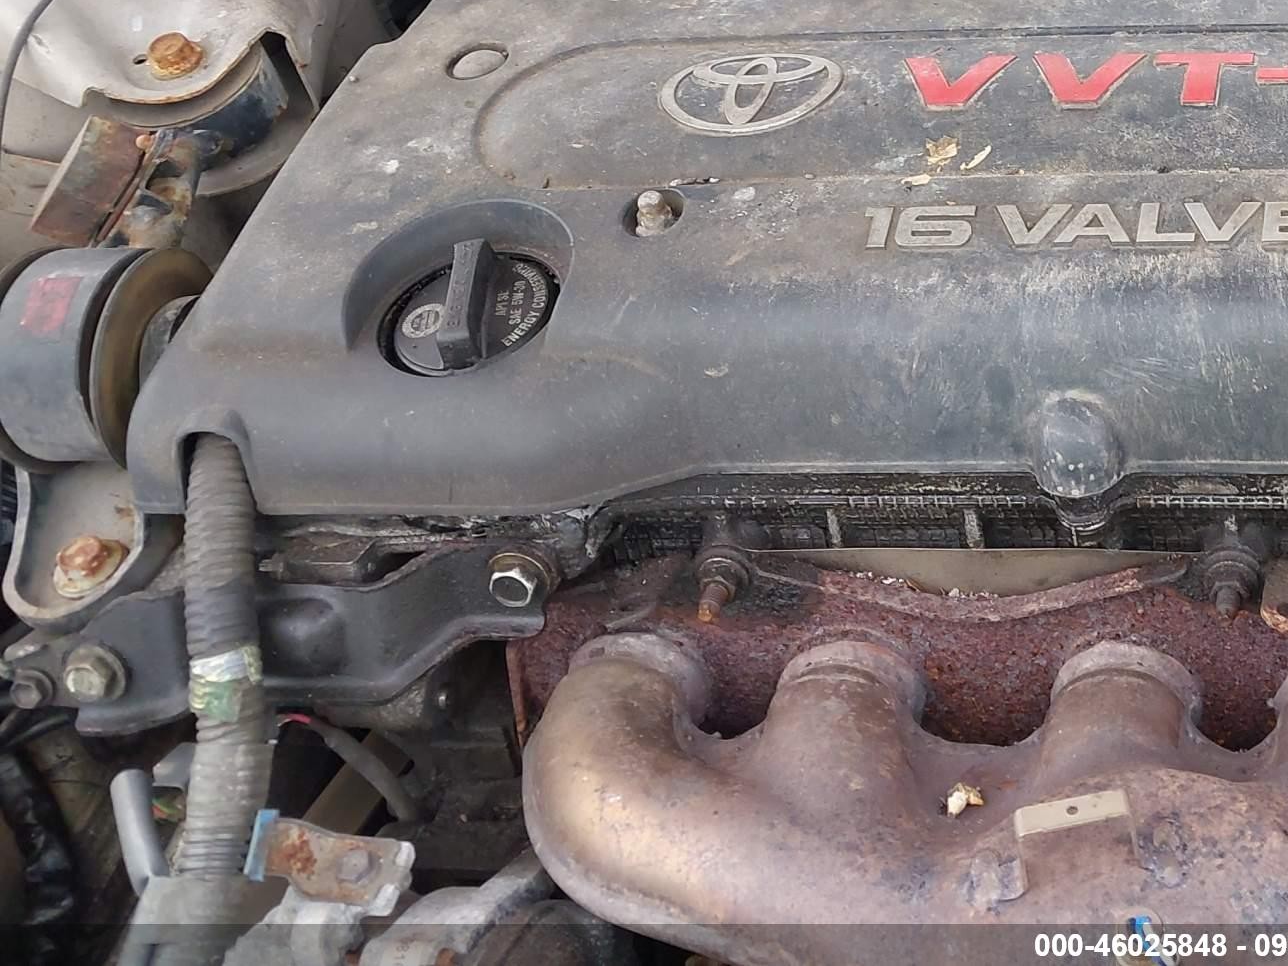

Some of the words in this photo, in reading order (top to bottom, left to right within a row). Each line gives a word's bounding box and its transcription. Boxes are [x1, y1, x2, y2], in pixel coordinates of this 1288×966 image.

[863, 204, 977, 250] 16
[501, 311, 540, 347] ENERGY
[508, 307, 522, 325] SAE
